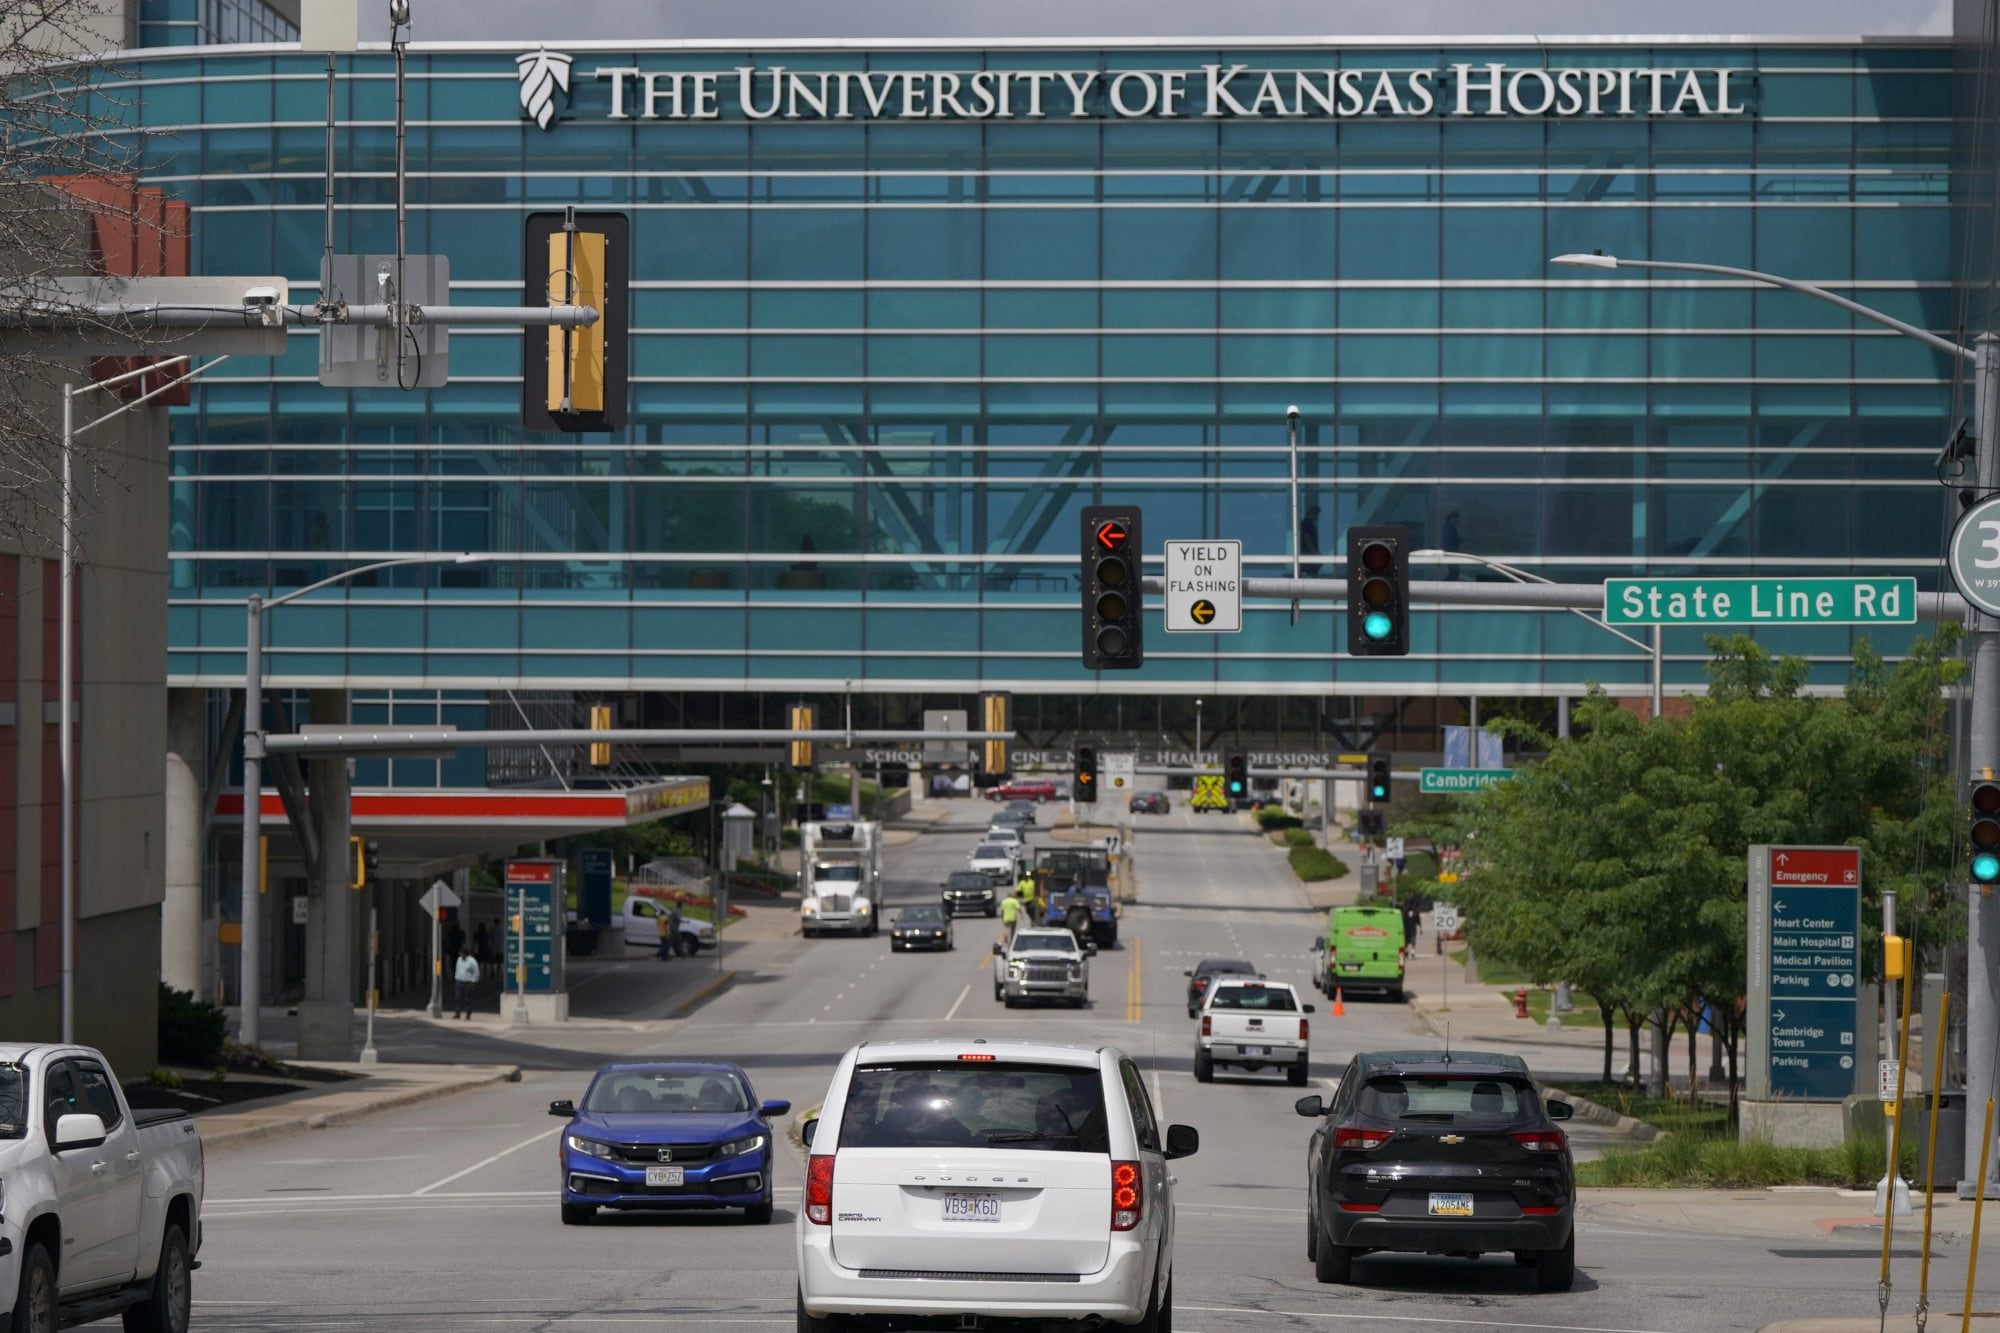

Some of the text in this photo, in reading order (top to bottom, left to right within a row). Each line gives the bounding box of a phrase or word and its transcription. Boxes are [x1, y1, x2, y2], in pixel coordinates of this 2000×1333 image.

[595, 62, 1746, 119] THE UNIVERSITY OF KANSAS HOSPITAL
[1179, 547, 1228, 562] YIELD
[1194, 565, 1213, 577] ON
[1169, 580, 1237, 593] FLASHING
[1975, 578, 1985, 589] W
[1621, 583, 1900, 619] State Line Rd
[865, 749, 923, 763] SCHOO
[1776, 871, 1829, 883] Emergency
[1436, 916, 1456, 928] 20
[1773, 918, 1835, 929] Heart Center
[1773, 936, 1798, 947] Main
[1800, 936, 1841, 949] Hospital
[1773, 955, 1853, 966] Medical Pavilion
[1773, 974, 1810, 987] Parking
[1772, 1026, 1825, 1039] Cambridge
[1772, 1037, 1805, 1048] Towers
[1772, 1056, 1809, 1069] Parking
[944, 1197, 998, 1216] VB9 K6D
